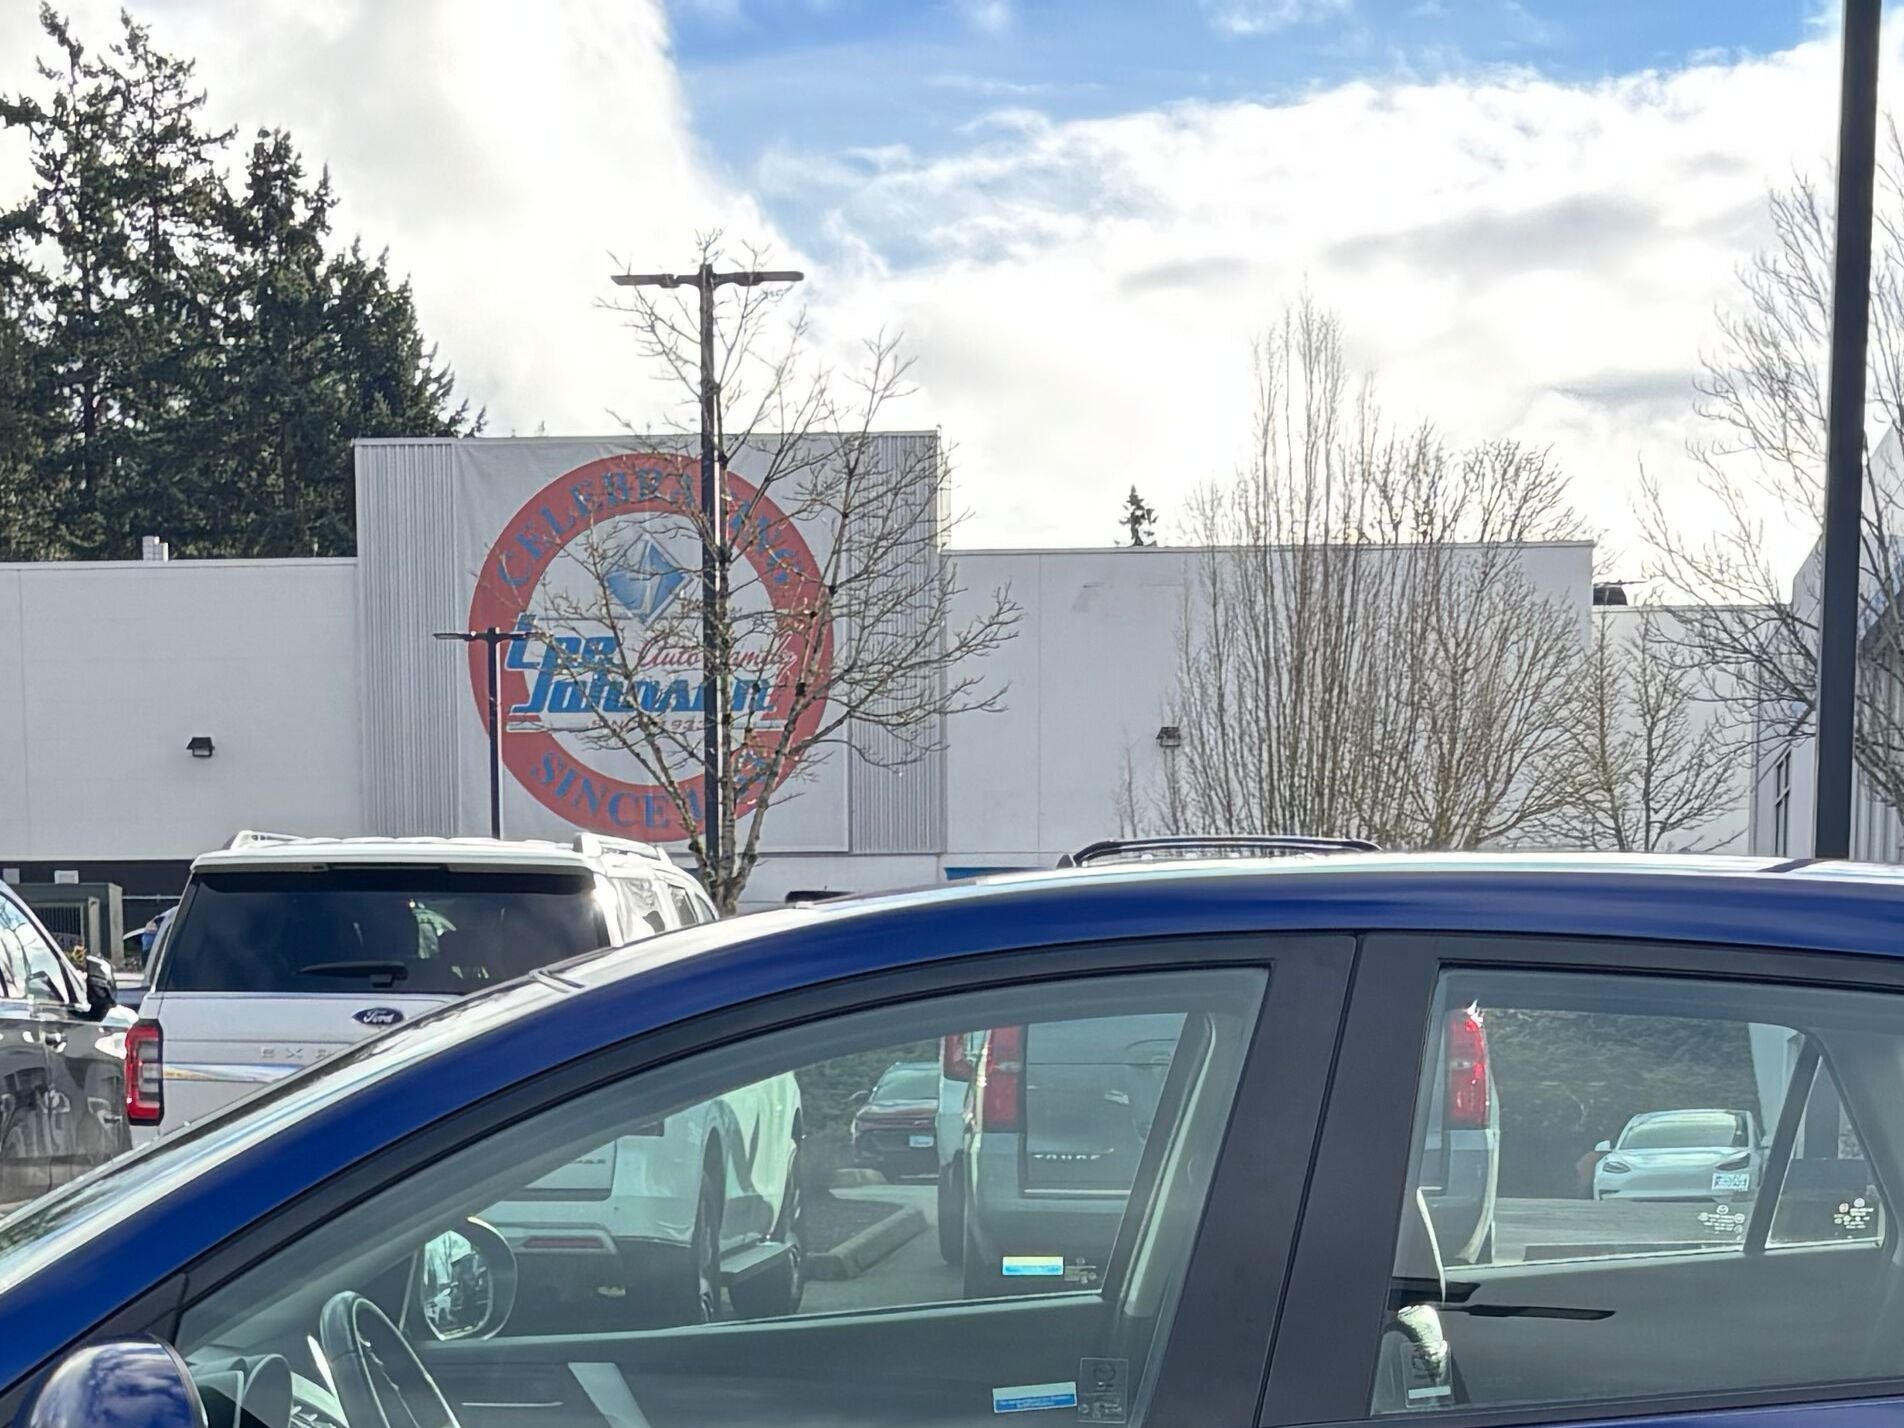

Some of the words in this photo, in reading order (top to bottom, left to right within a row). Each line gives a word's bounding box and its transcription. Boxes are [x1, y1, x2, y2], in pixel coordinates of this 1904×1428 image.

[505, 611, 618, 670] Lee
[533, 752, 671, 828] SINCE
[362, 1010, 395, 1024] Ford
